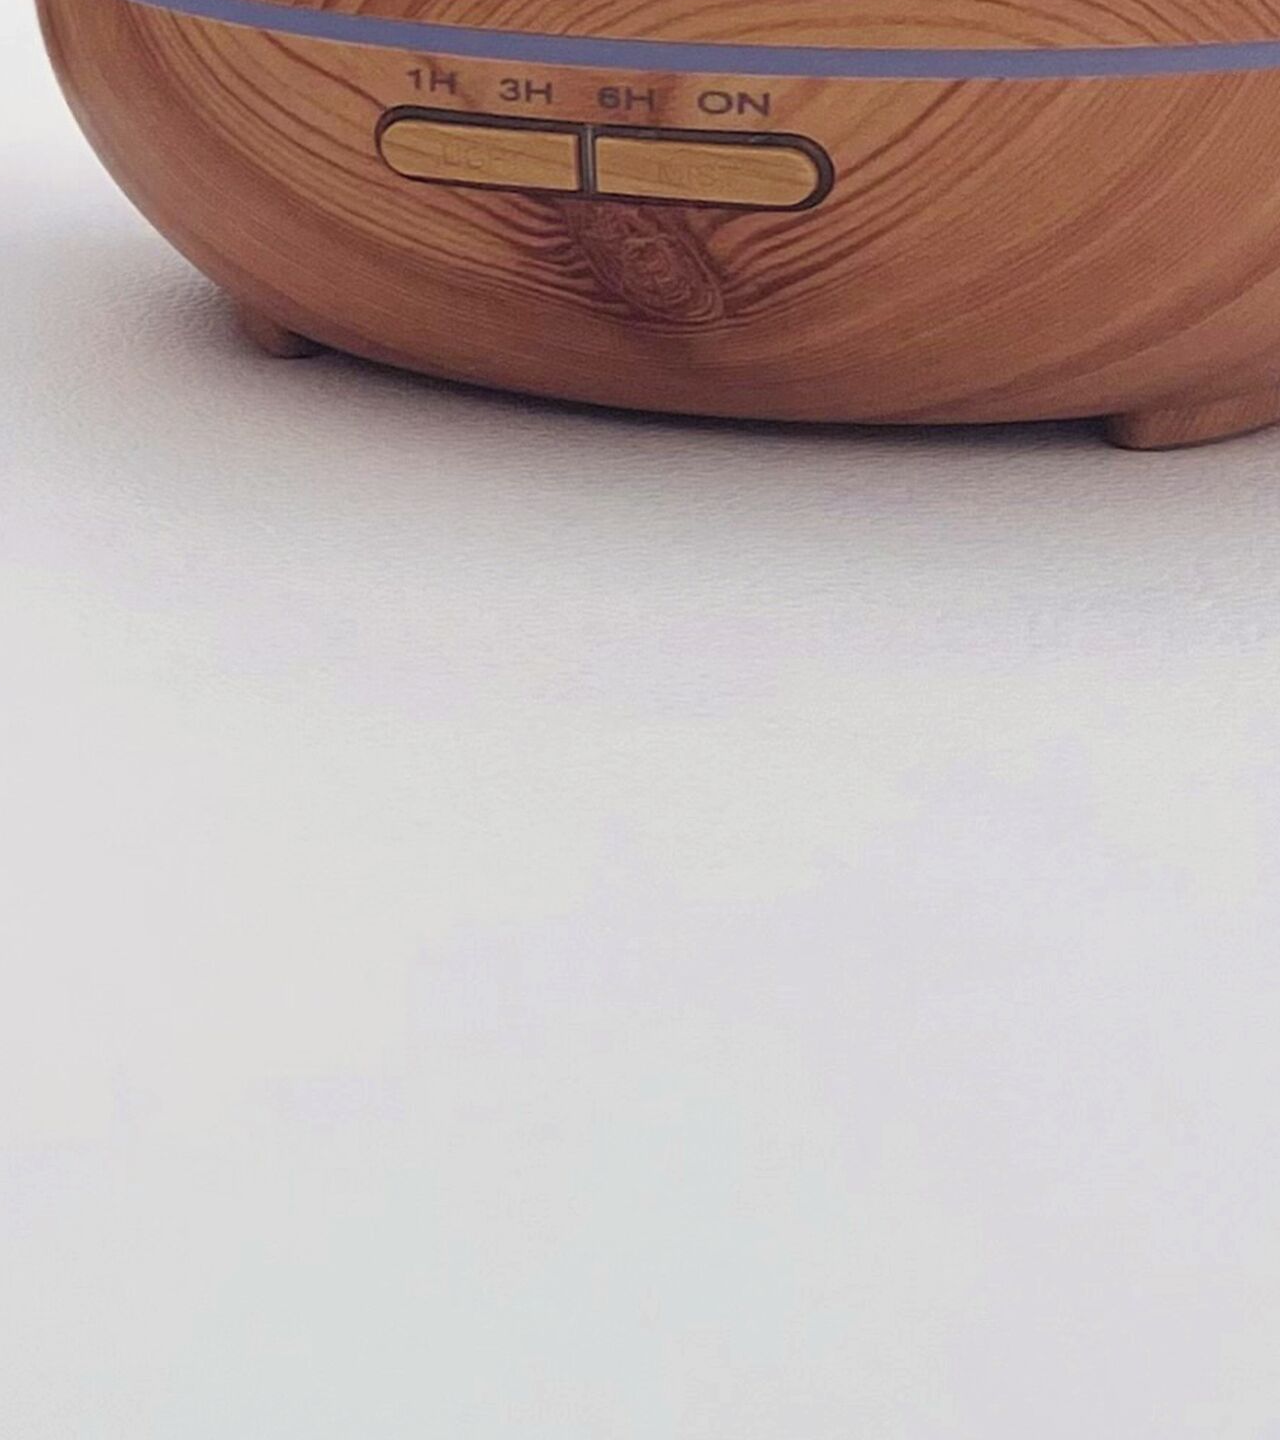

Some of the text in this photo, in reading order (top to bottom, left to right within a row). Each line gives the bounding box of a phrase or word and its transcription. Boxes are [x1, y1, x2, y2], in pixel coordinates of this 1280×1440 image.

[406, 68, 773, 117] 1H 3H 6H ON
